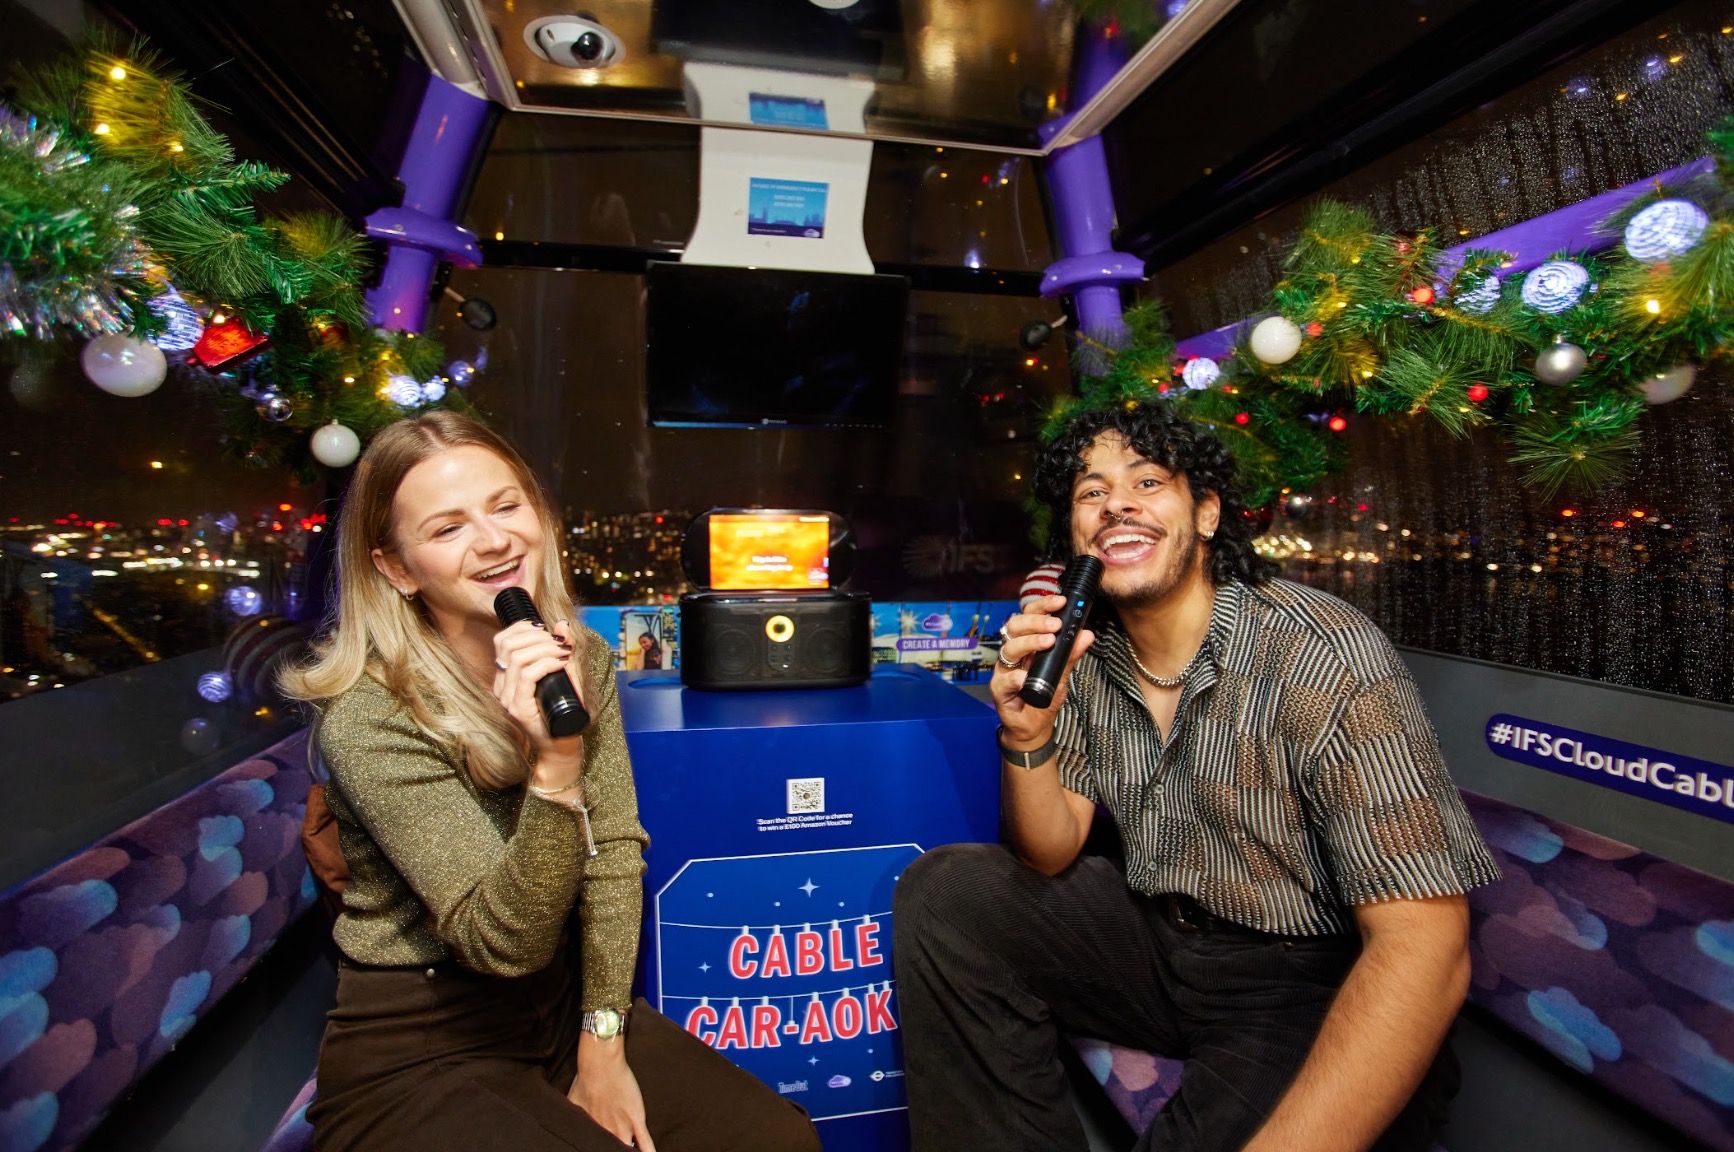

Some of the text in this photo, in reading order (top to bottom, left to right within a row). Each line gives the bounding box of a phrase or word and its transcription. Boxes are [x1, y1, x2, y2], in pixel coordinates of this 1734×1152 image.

[902, 639, 971, 650] CREATE A MEMORY
[728, 920, 883, 979] CABLE
